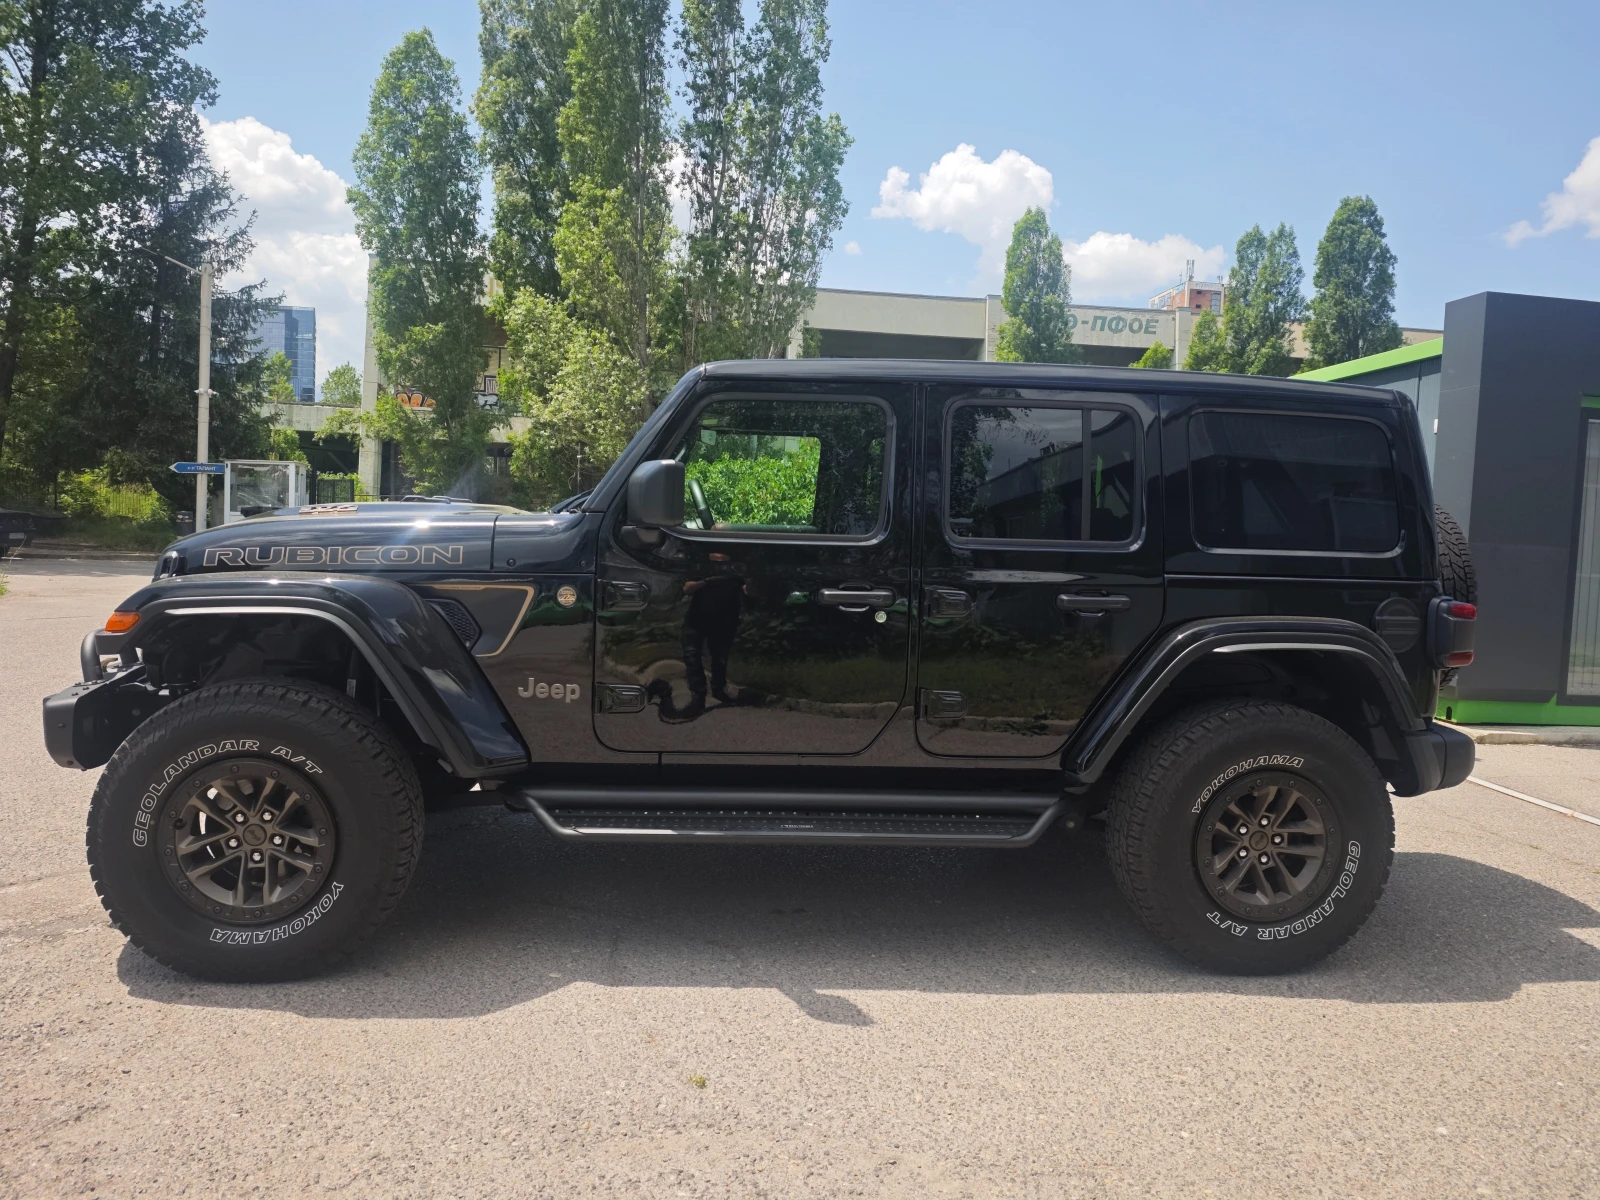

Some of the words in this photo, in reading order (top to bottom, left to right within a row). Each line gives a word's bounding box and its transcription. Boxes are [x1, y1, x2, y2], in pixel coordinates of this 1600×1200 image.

[203, 545, 464, 567] RUBICON
[517, 677, 581, 704] Jeep
[133, 739, 260, 847] GEOLANDAR
[270, 746, 323, 774] A/T
[1191, 754, 1304, 814] YOKOHAMA
[209, 881, 345, 945] YOKOHAMA
[1257, 840, 1361, 940] GEOLANDAR
[1206, 911, 1248, 937] A/T
